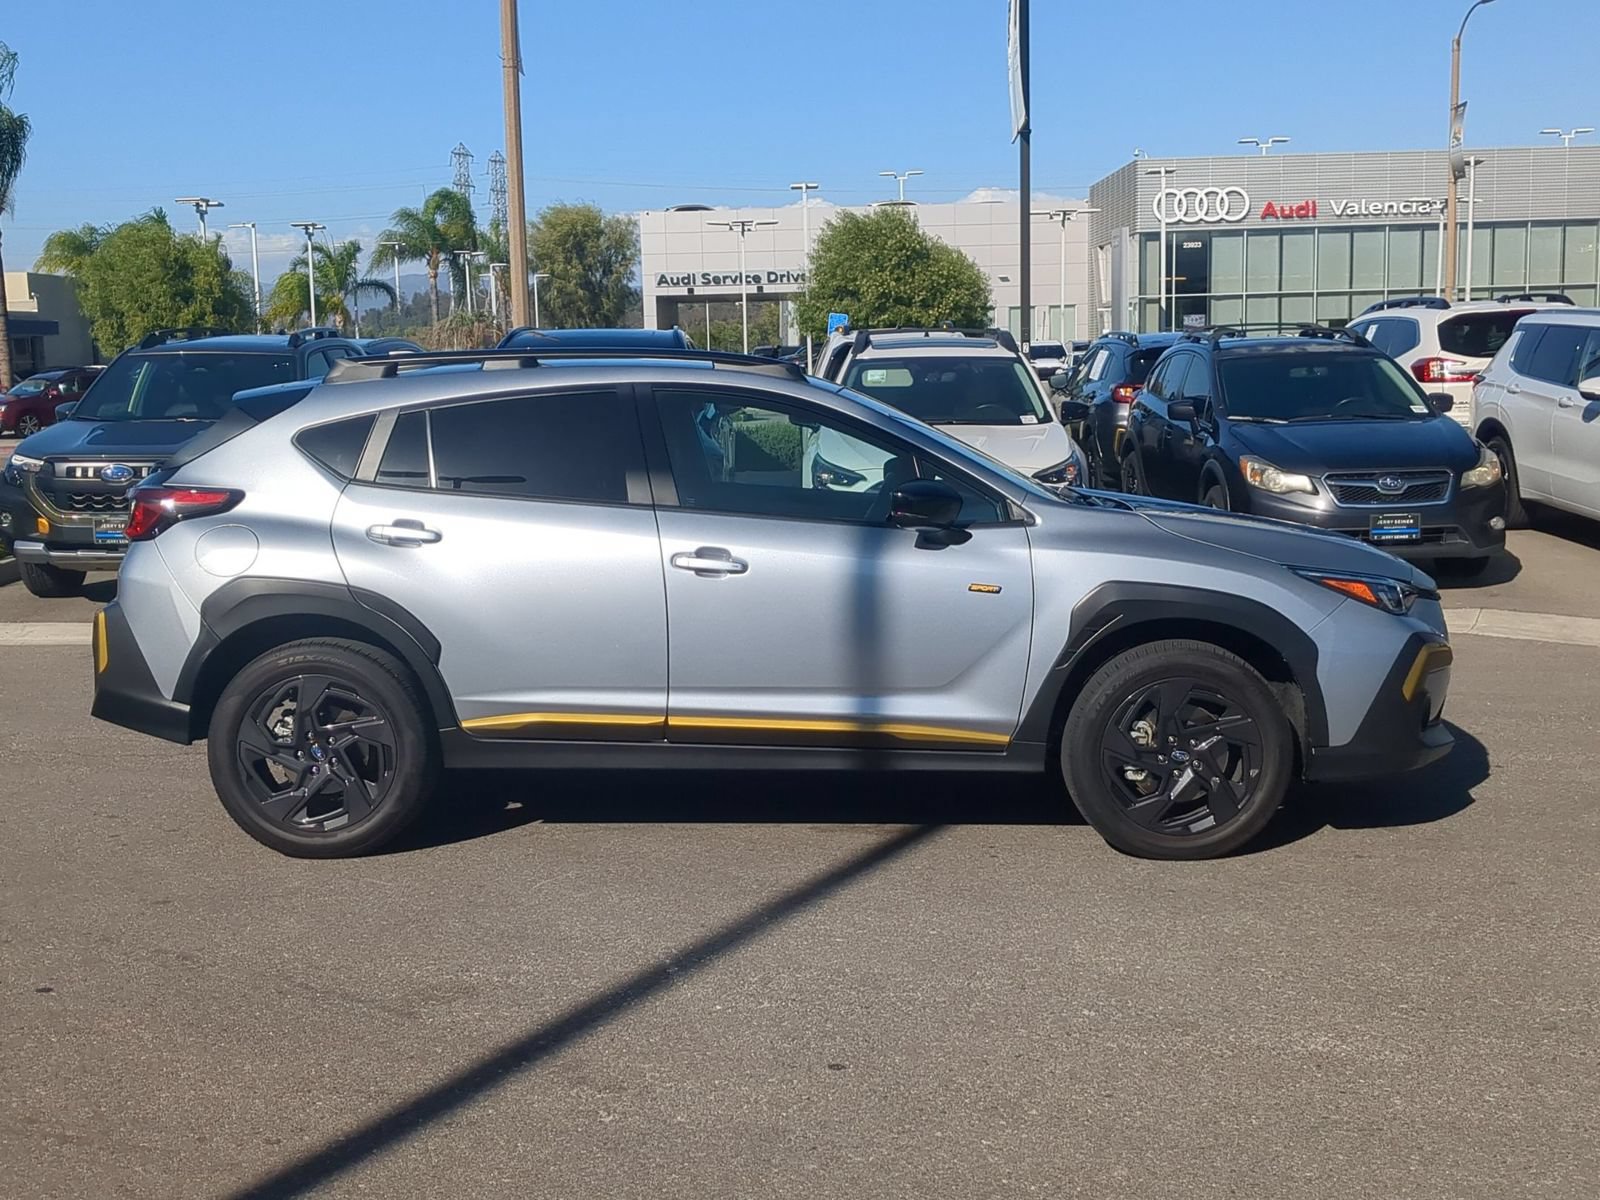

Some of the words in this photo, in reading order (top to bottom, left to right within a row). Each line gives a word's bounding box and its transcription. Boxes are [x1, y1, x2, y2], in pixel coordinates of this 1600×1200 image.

[1260, 200, 1317, 219] Audi
[1330, 199, 1431, 217] Valencia
[657, 273, 696, 286] Audi
[701, 270, 762, 285] Service
[970, 584, 1000, 593] SPORT
